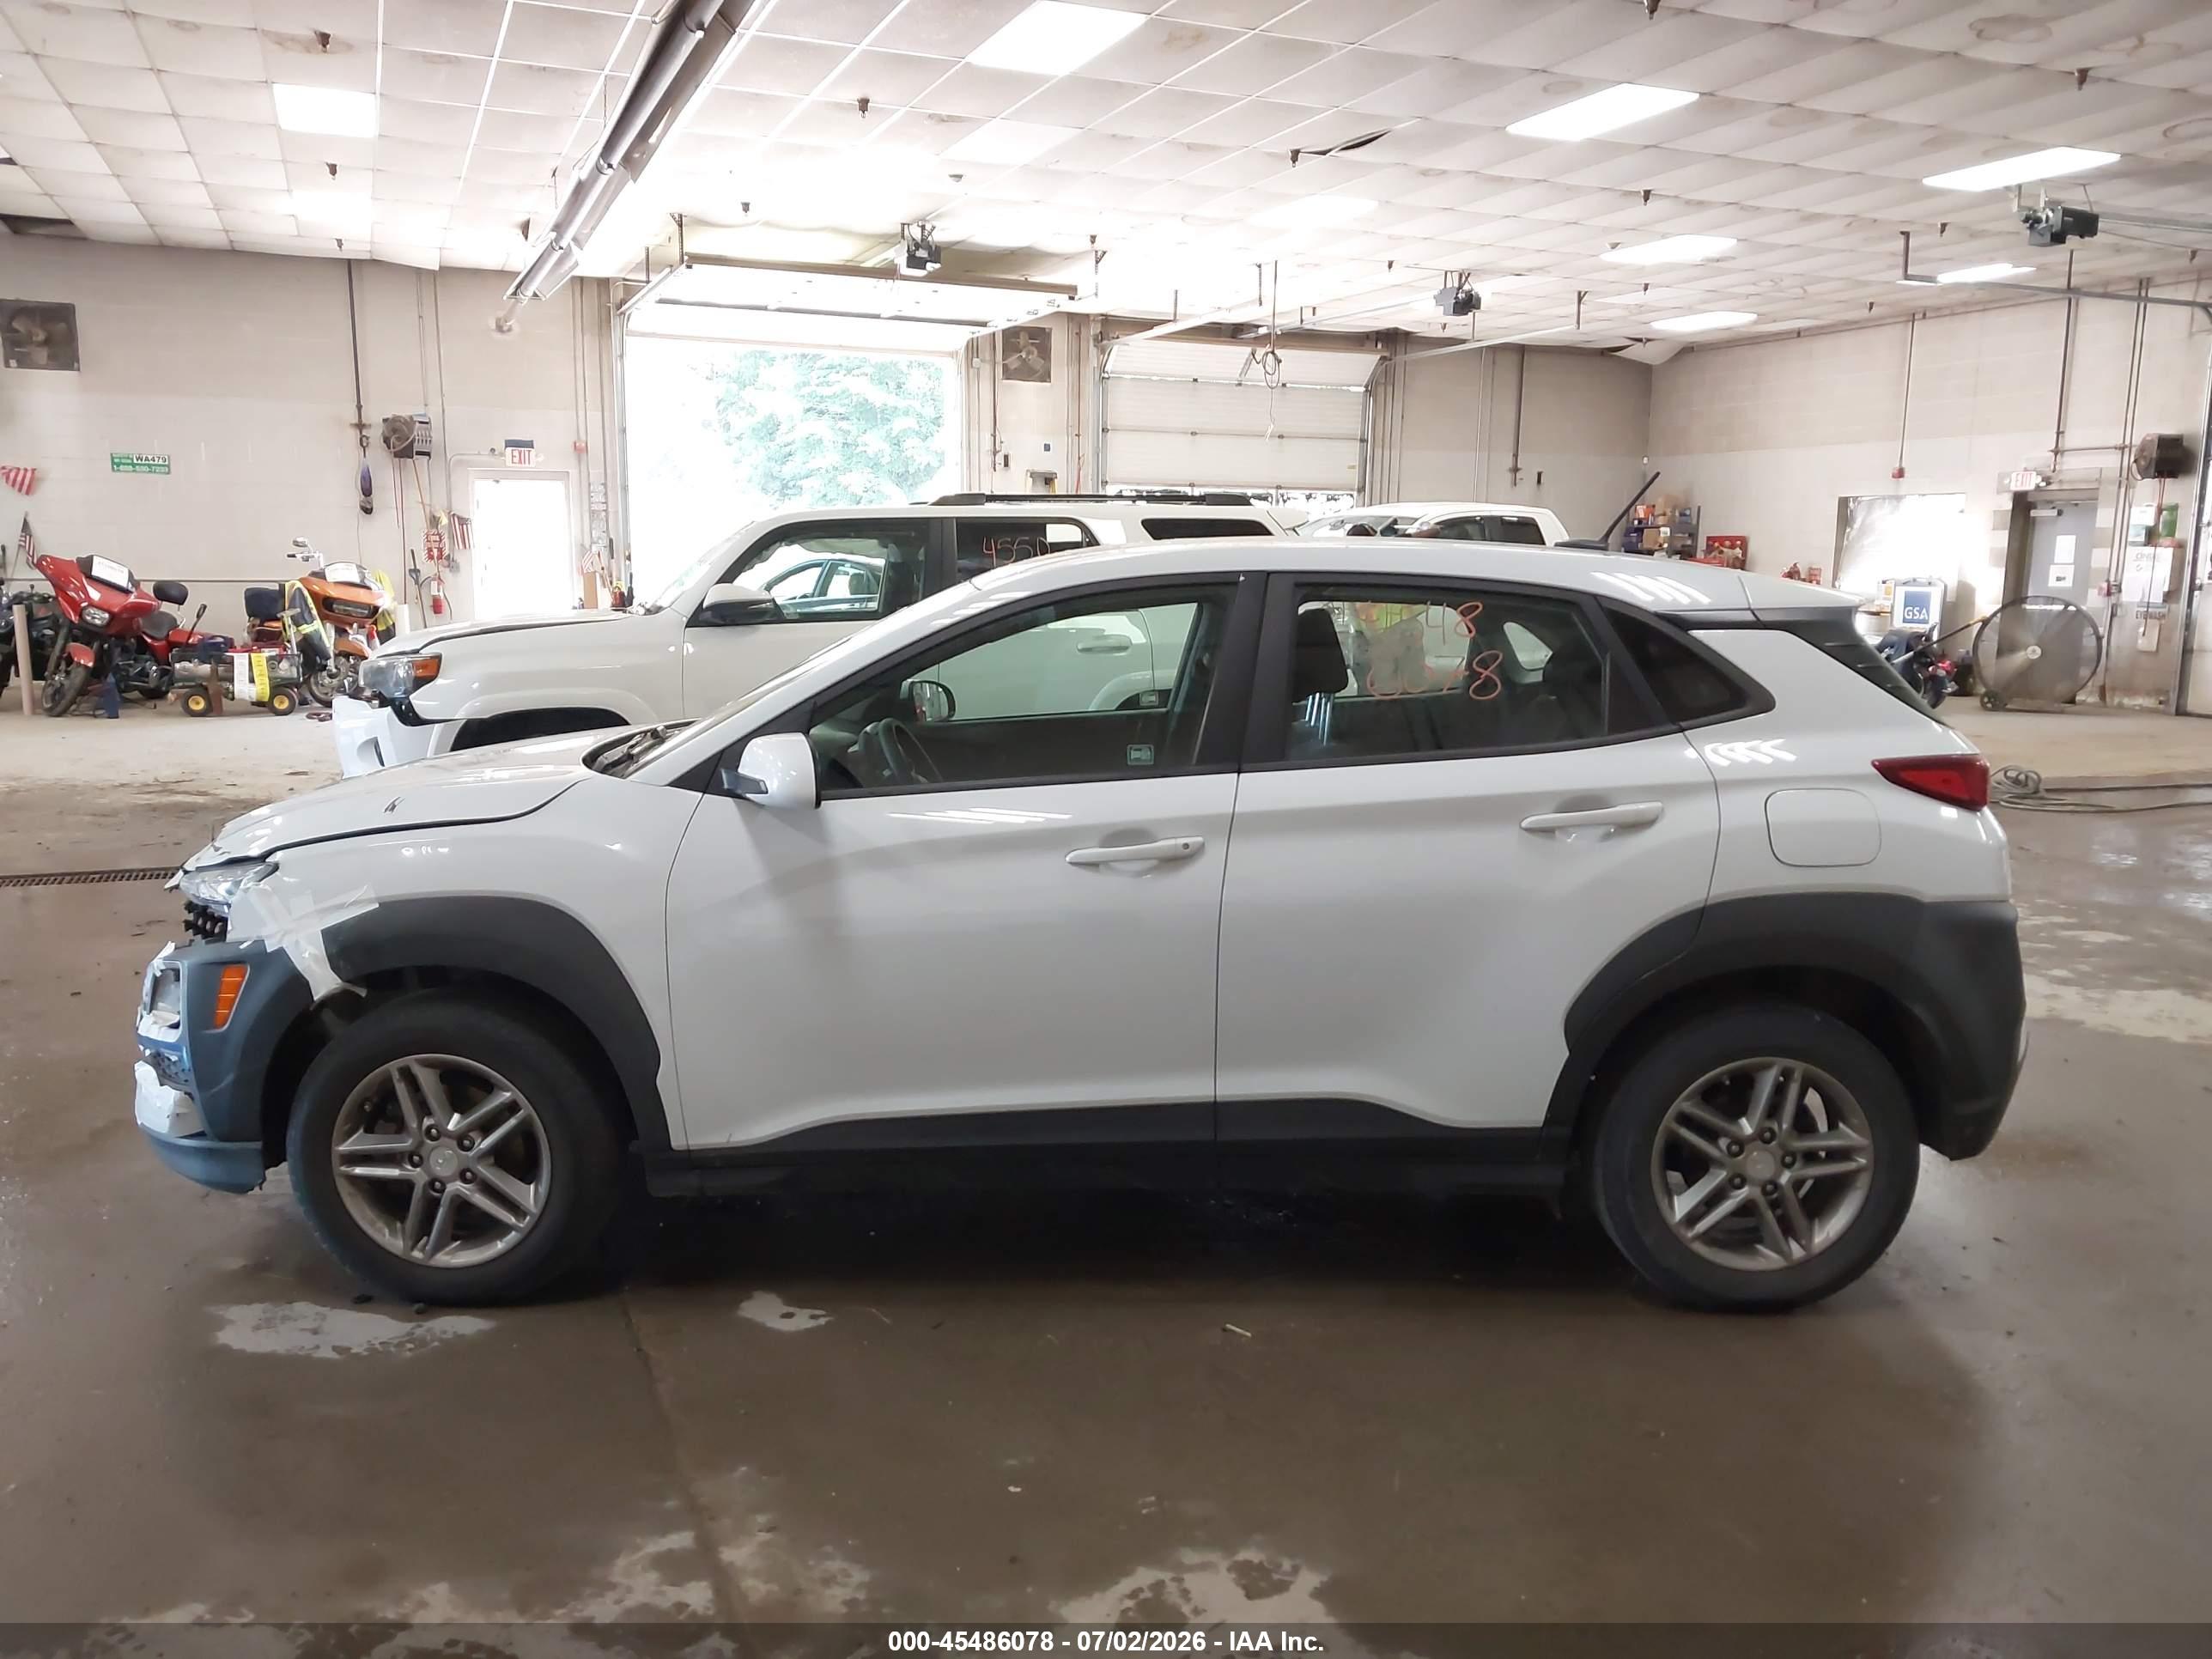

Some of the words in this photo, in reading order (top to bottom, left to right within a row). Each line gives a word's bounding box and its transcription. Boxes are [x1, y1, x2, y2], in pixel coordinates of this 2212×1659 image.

[135, 455, 167, 464] WA479
[511, 449, 532, 465] EXIT
[2014, 472, 2034, 489] EXIT
[1904, 606, 1929, 620] GSA
